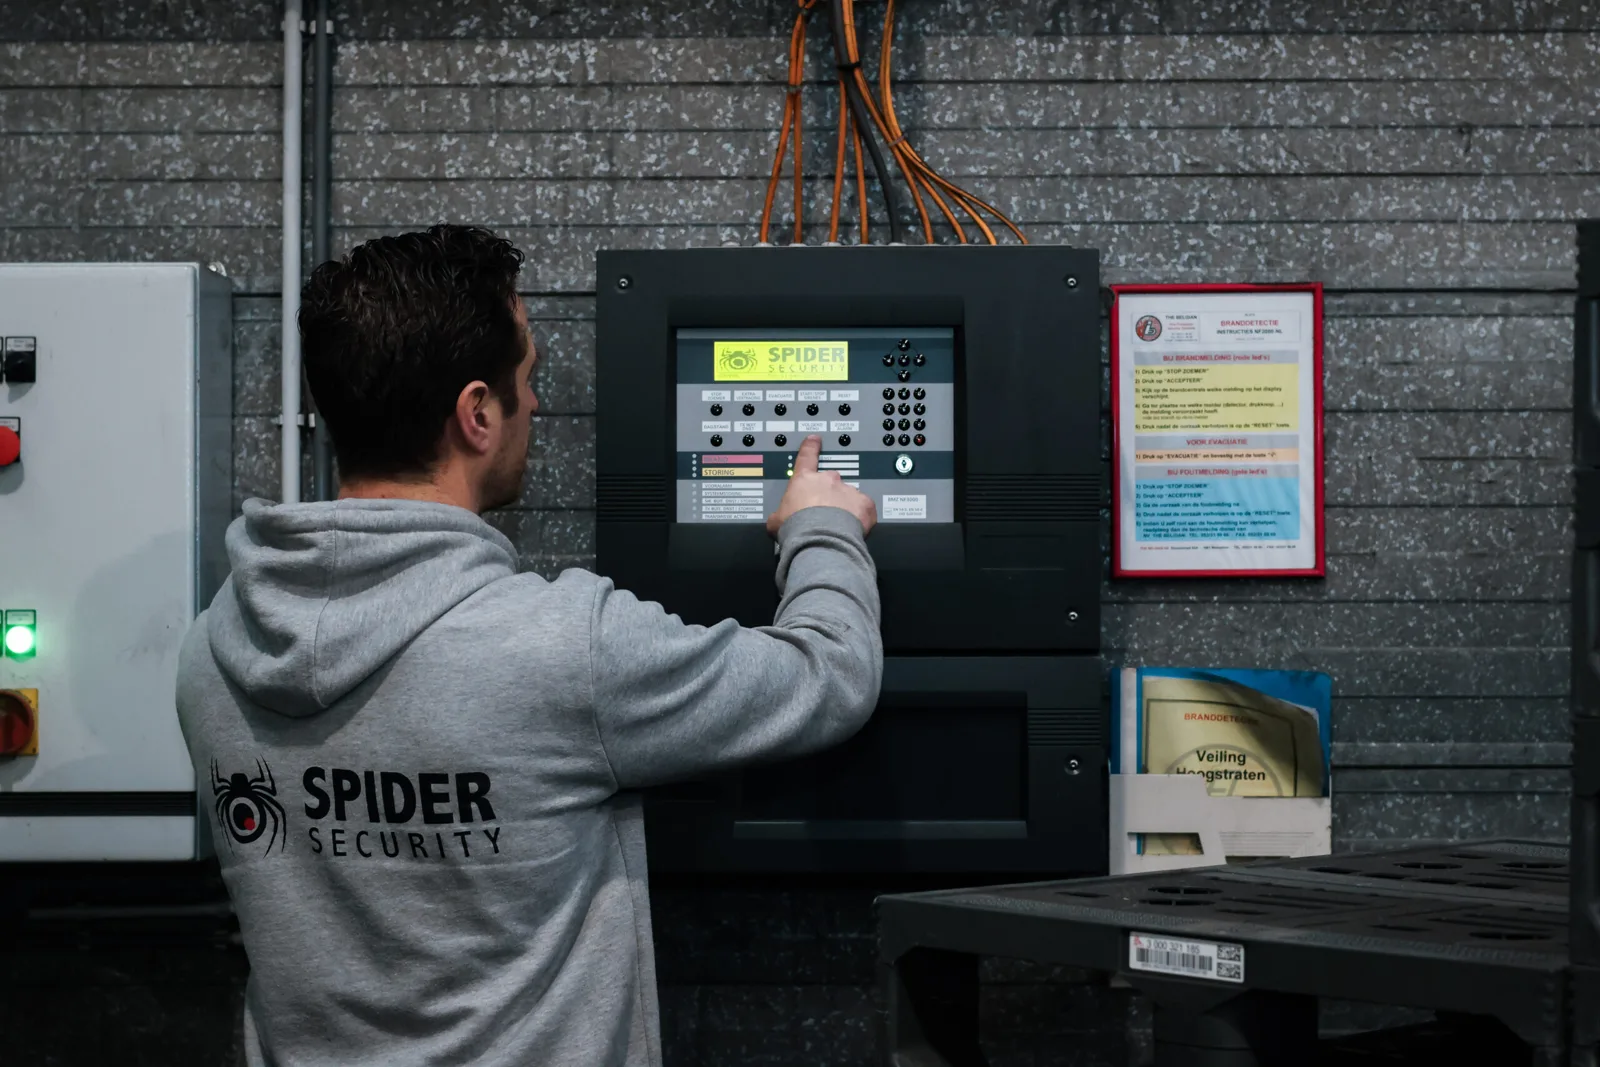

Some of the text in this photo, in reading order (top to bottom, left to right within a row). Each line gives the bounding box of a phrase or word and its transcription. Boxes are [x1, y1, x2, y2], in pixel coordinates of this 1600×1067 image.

[768, 347, 845, 362] SPIDER
[768, 364, 845, 373] SECURITY
[1184, 713, 1259, 725] BRANDDETEC
[1196, 750, 1246, 766] Veiling
[302, 766, 496, 825] SPIDER
[308, 827, 500, 859] SECURITY
